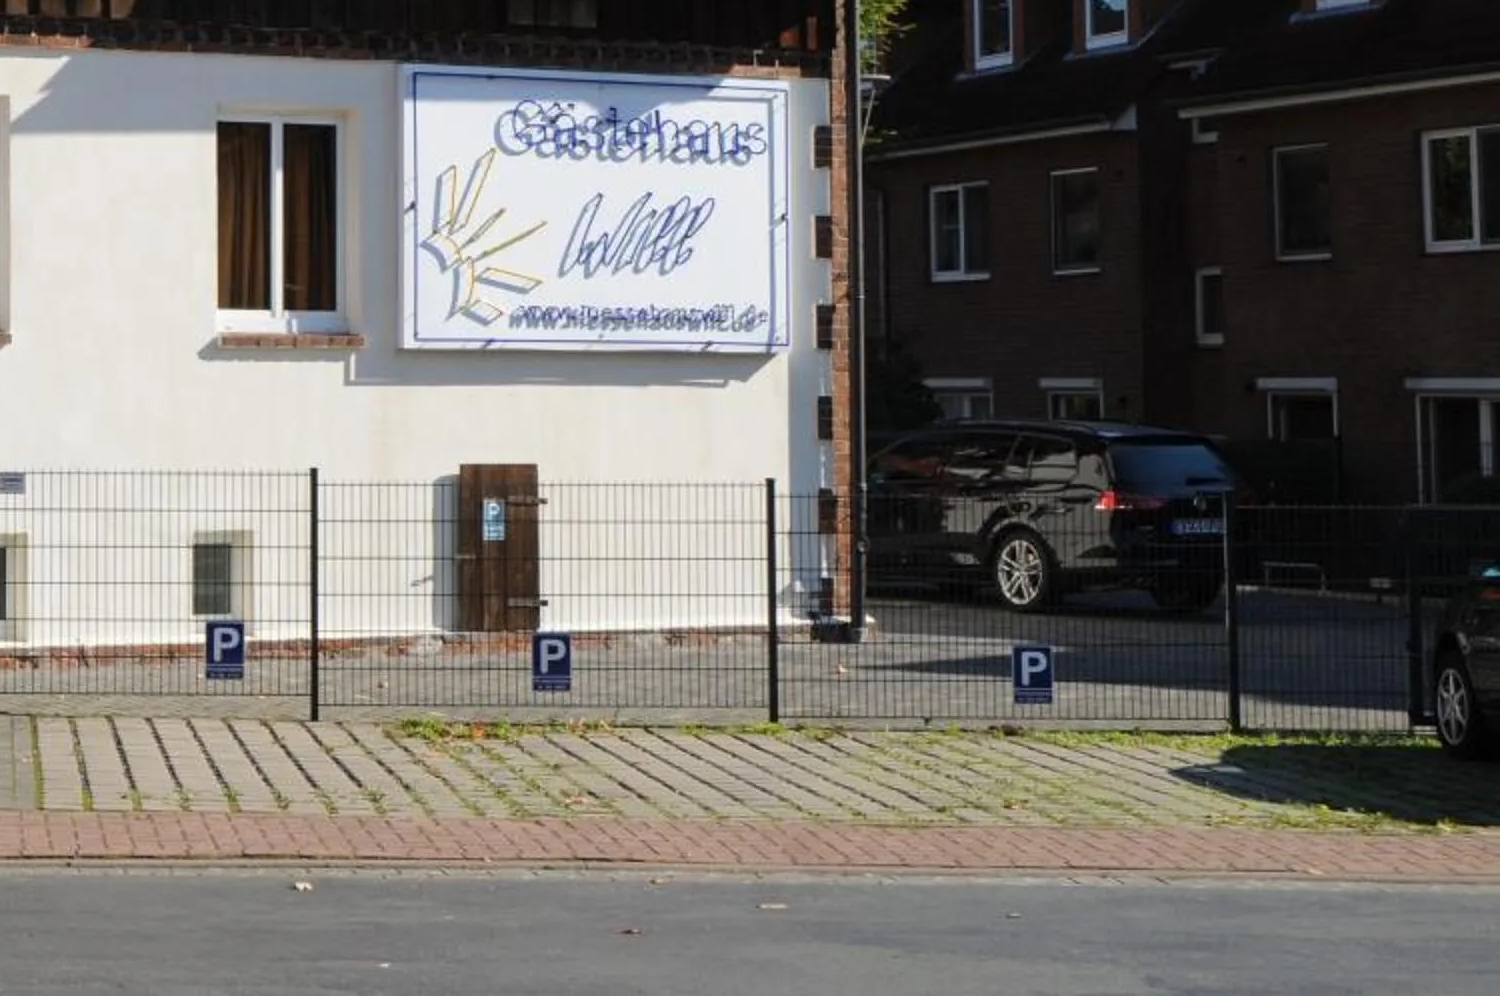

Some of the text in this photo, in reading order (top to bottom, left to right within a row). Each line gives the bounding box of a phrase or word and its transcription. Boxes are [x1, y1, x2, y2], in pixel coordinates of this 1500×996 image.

[508, 100, 767, 159] Gästehaus
[488, 502, 501, 521] P
[213, 627, 240, 662] P
[540, 639, 566, 675] P
[1021, 650, 1048, 686] P
